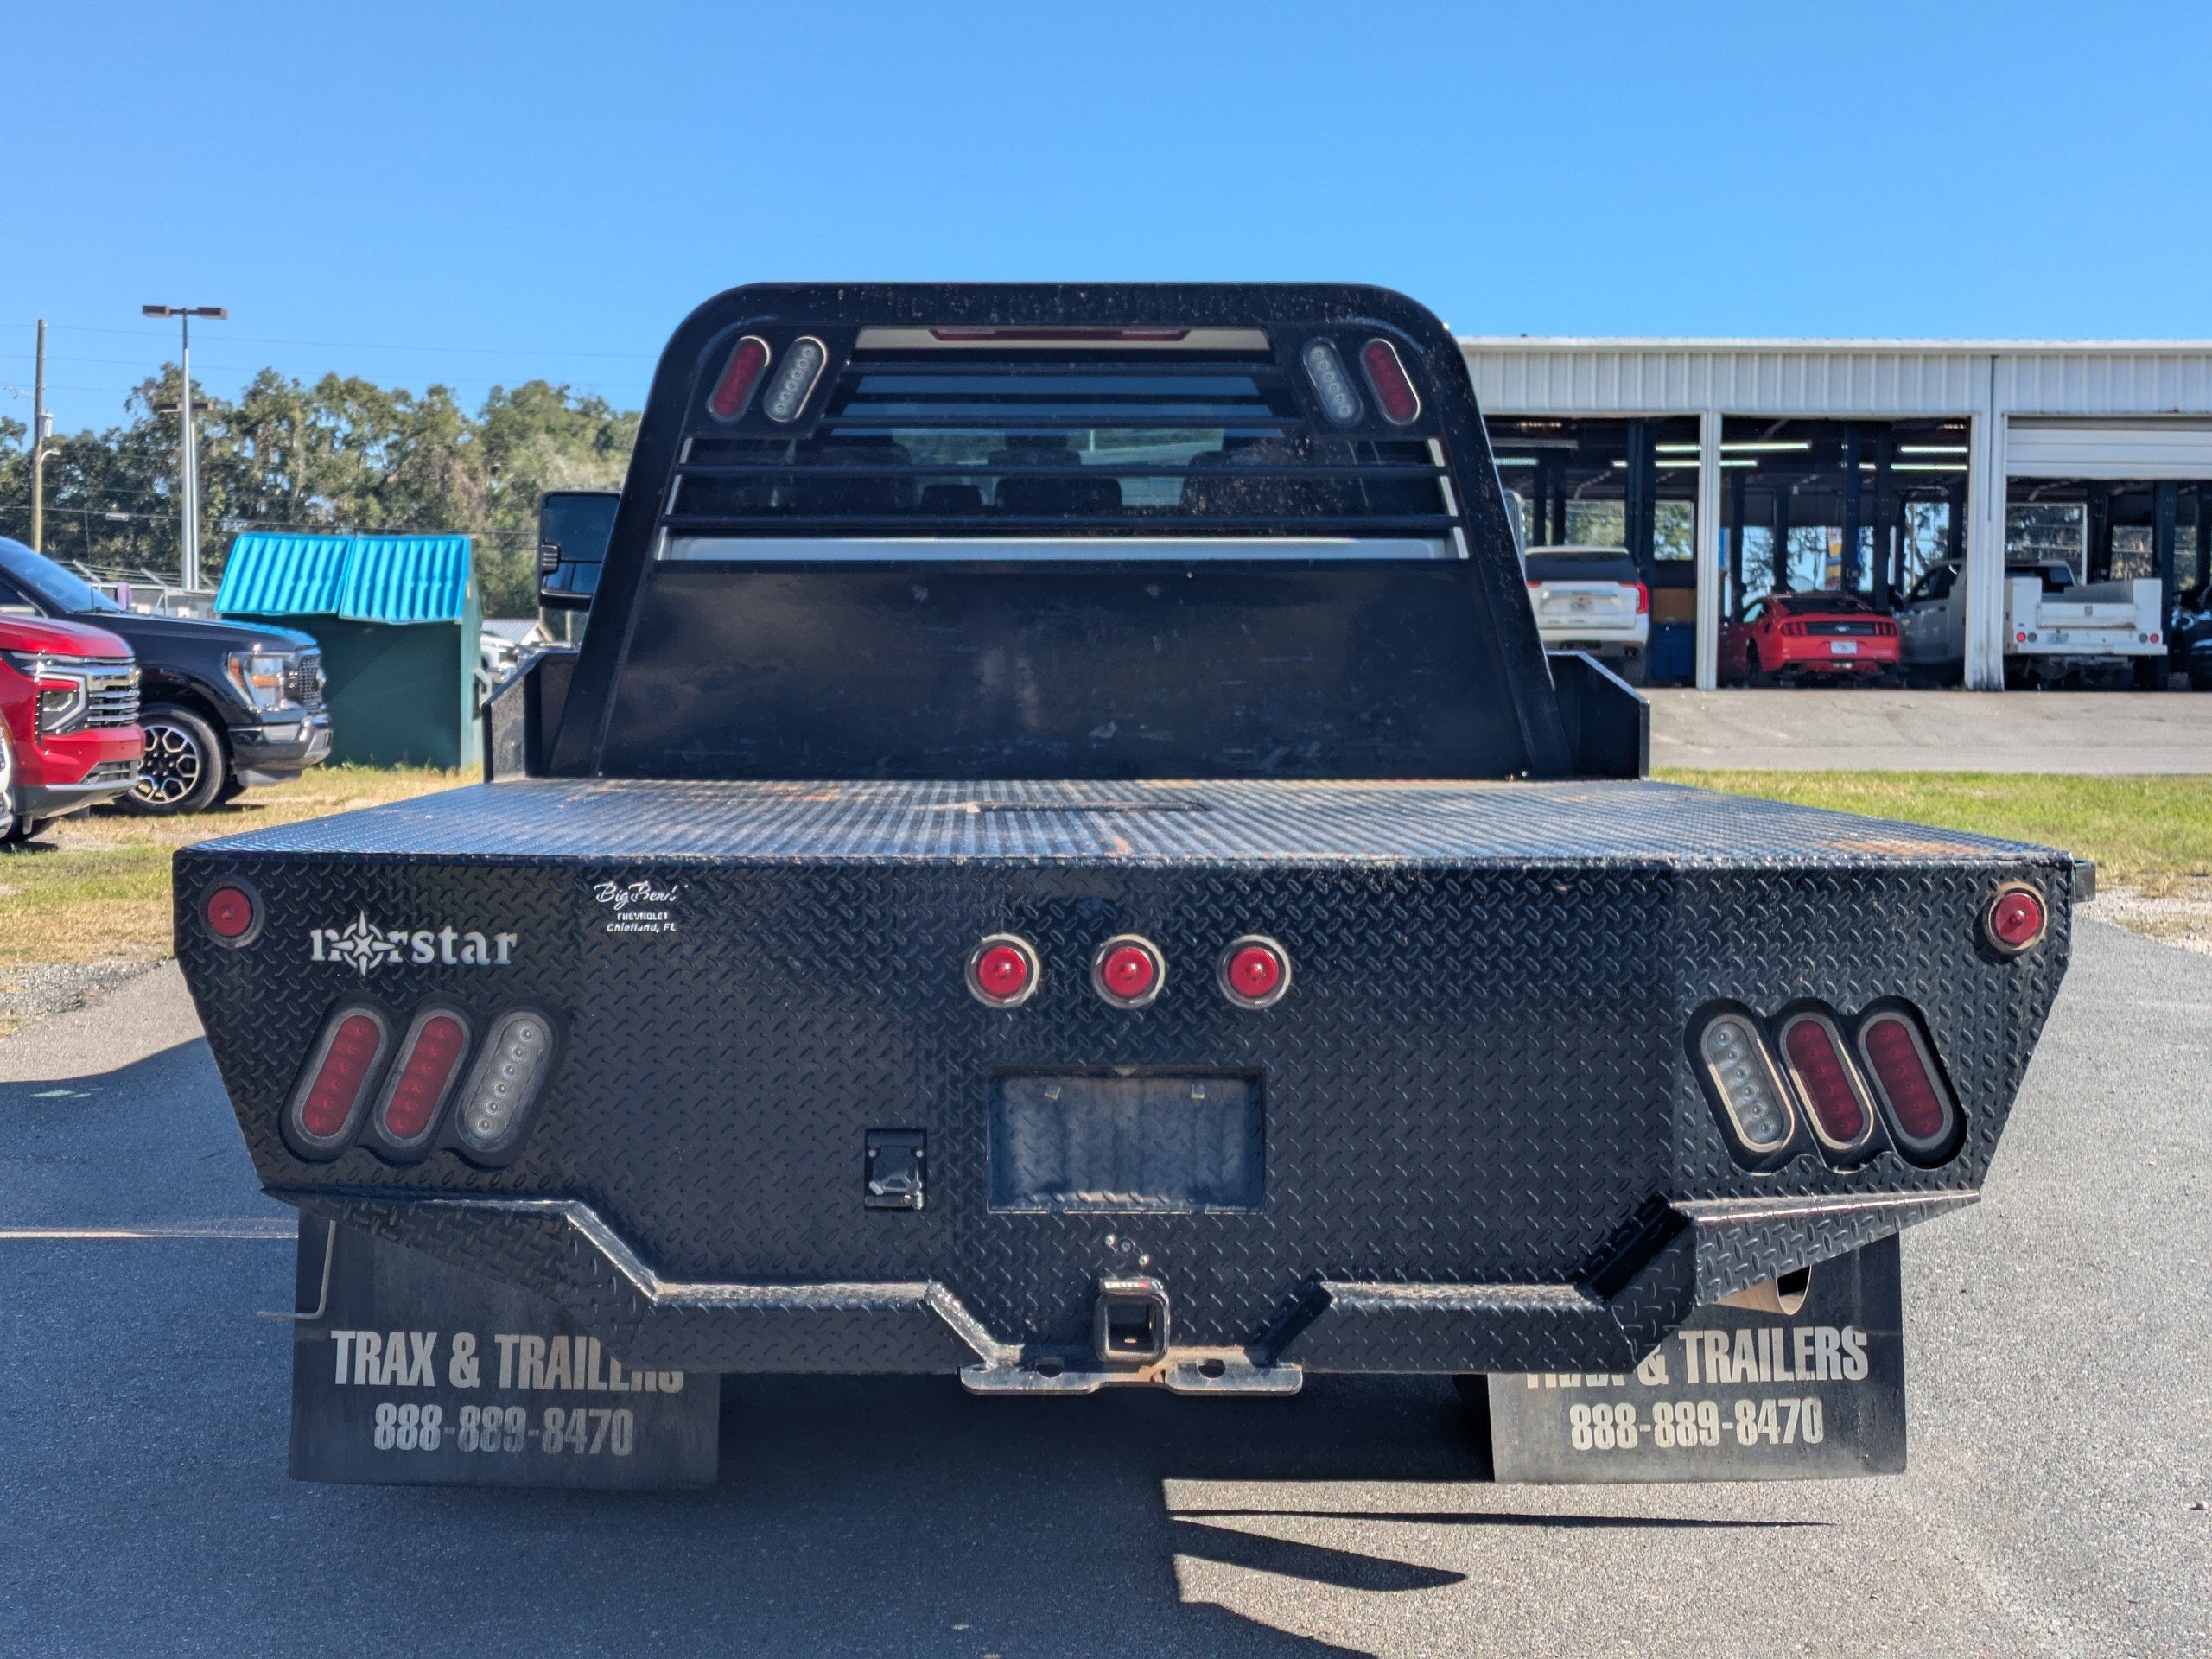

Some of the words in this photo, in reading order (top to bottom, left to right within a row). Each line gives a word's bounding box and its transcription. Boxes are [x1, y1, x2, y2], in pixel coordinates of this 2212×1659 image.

[593, 880, 629, 911] Big
[310, 911, 518, 976] norstar
[607, 923, 659, 933] Chiefland,
[663, 923, 677, 931] FL
[330, 1330, 437, 1387] TRAX
[448, 1332, 480, 1389] &
[1637, 1344, 1669, 1386] &
[1678, 1325, 1869, 1384] TRAILERS
[373, 1402, 634, 1457] 888-889-8470
[1569, 1396, 1824, 1451] 888-889-8470
